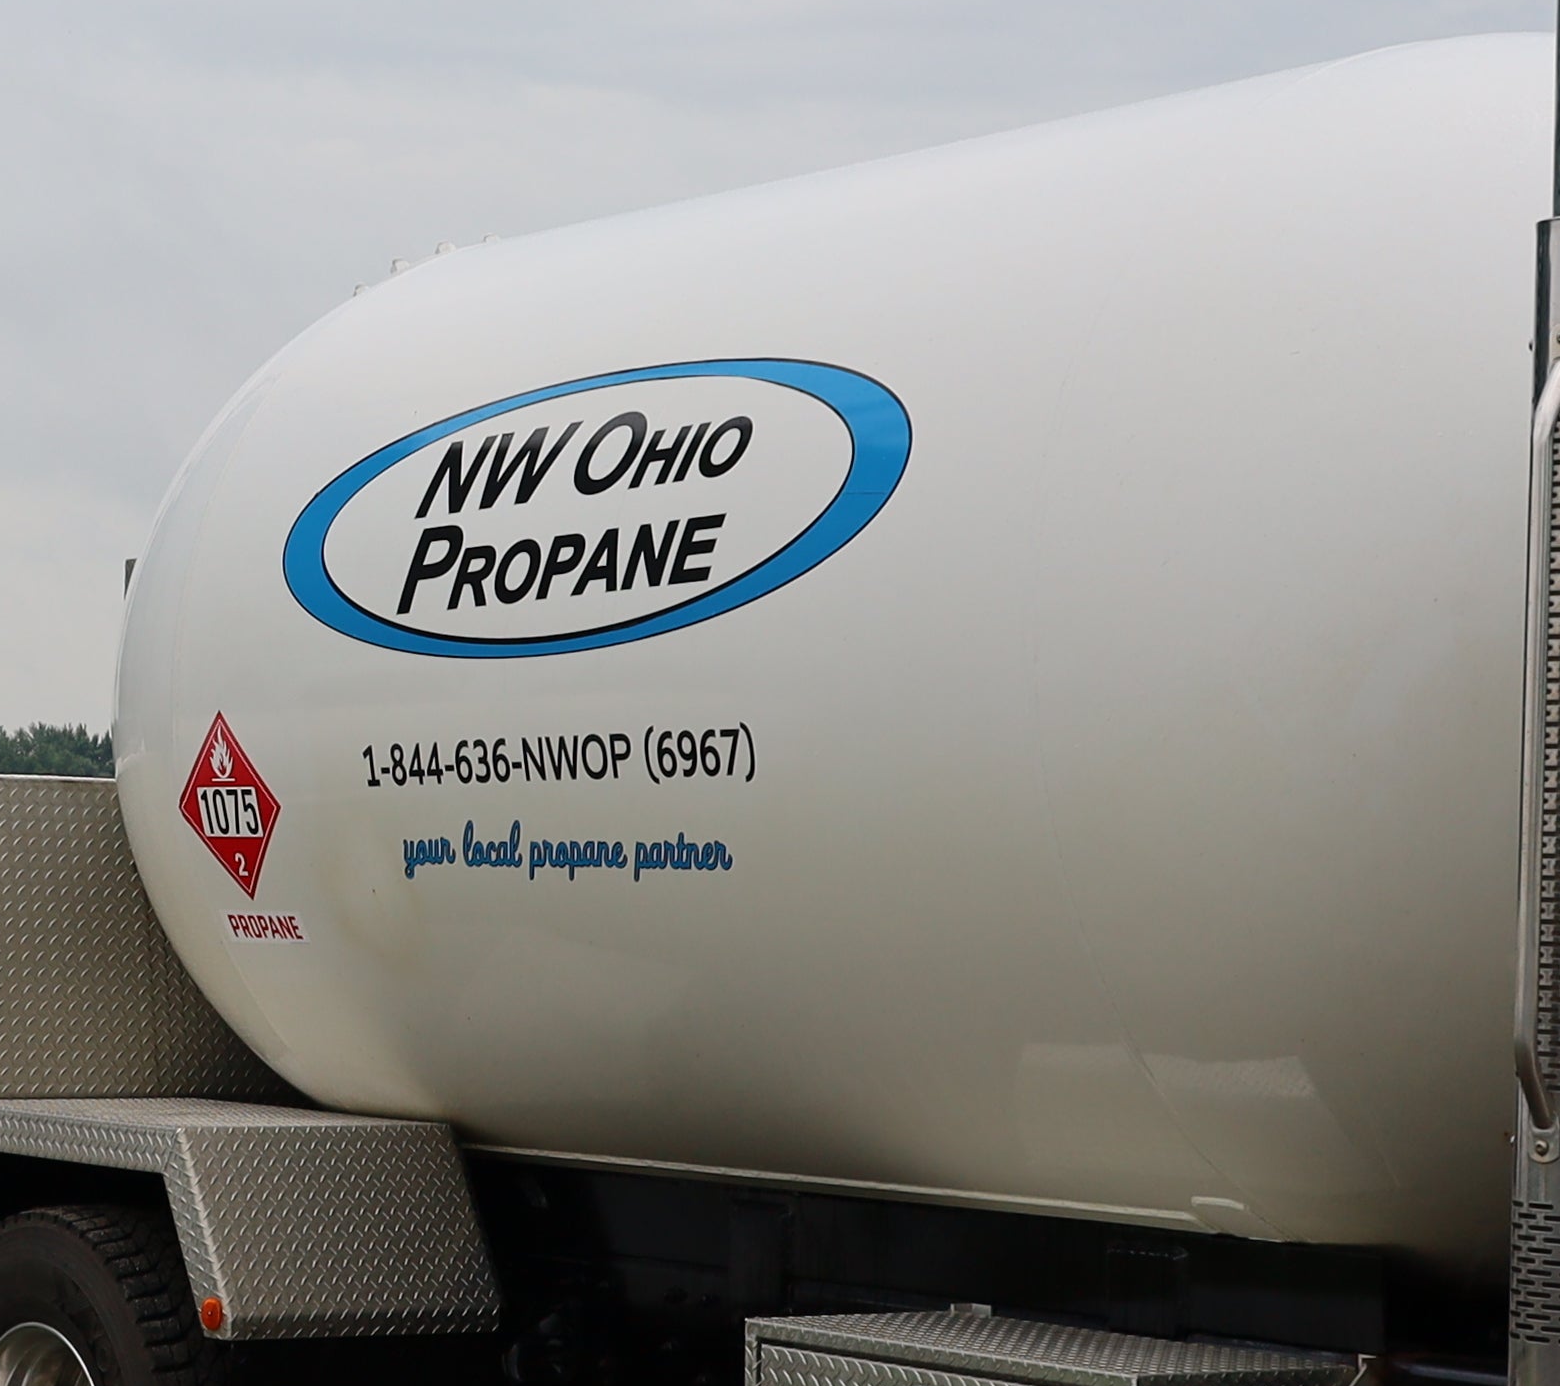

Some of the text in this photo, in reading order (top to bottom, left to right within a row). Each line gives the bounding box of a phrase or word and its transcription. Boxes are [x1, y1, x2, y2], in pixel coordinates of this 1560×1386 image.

[415, 421, 582, 519] NW
[363, 722, 755, 787] 1-844-636-NWOP (6967)
[200, 789, 259, 835] 1075
[235, 852, 249, 876] 2
[404, 820, 733, 882] your local propane partner
[228, 914, 304, 940] PROPANE
